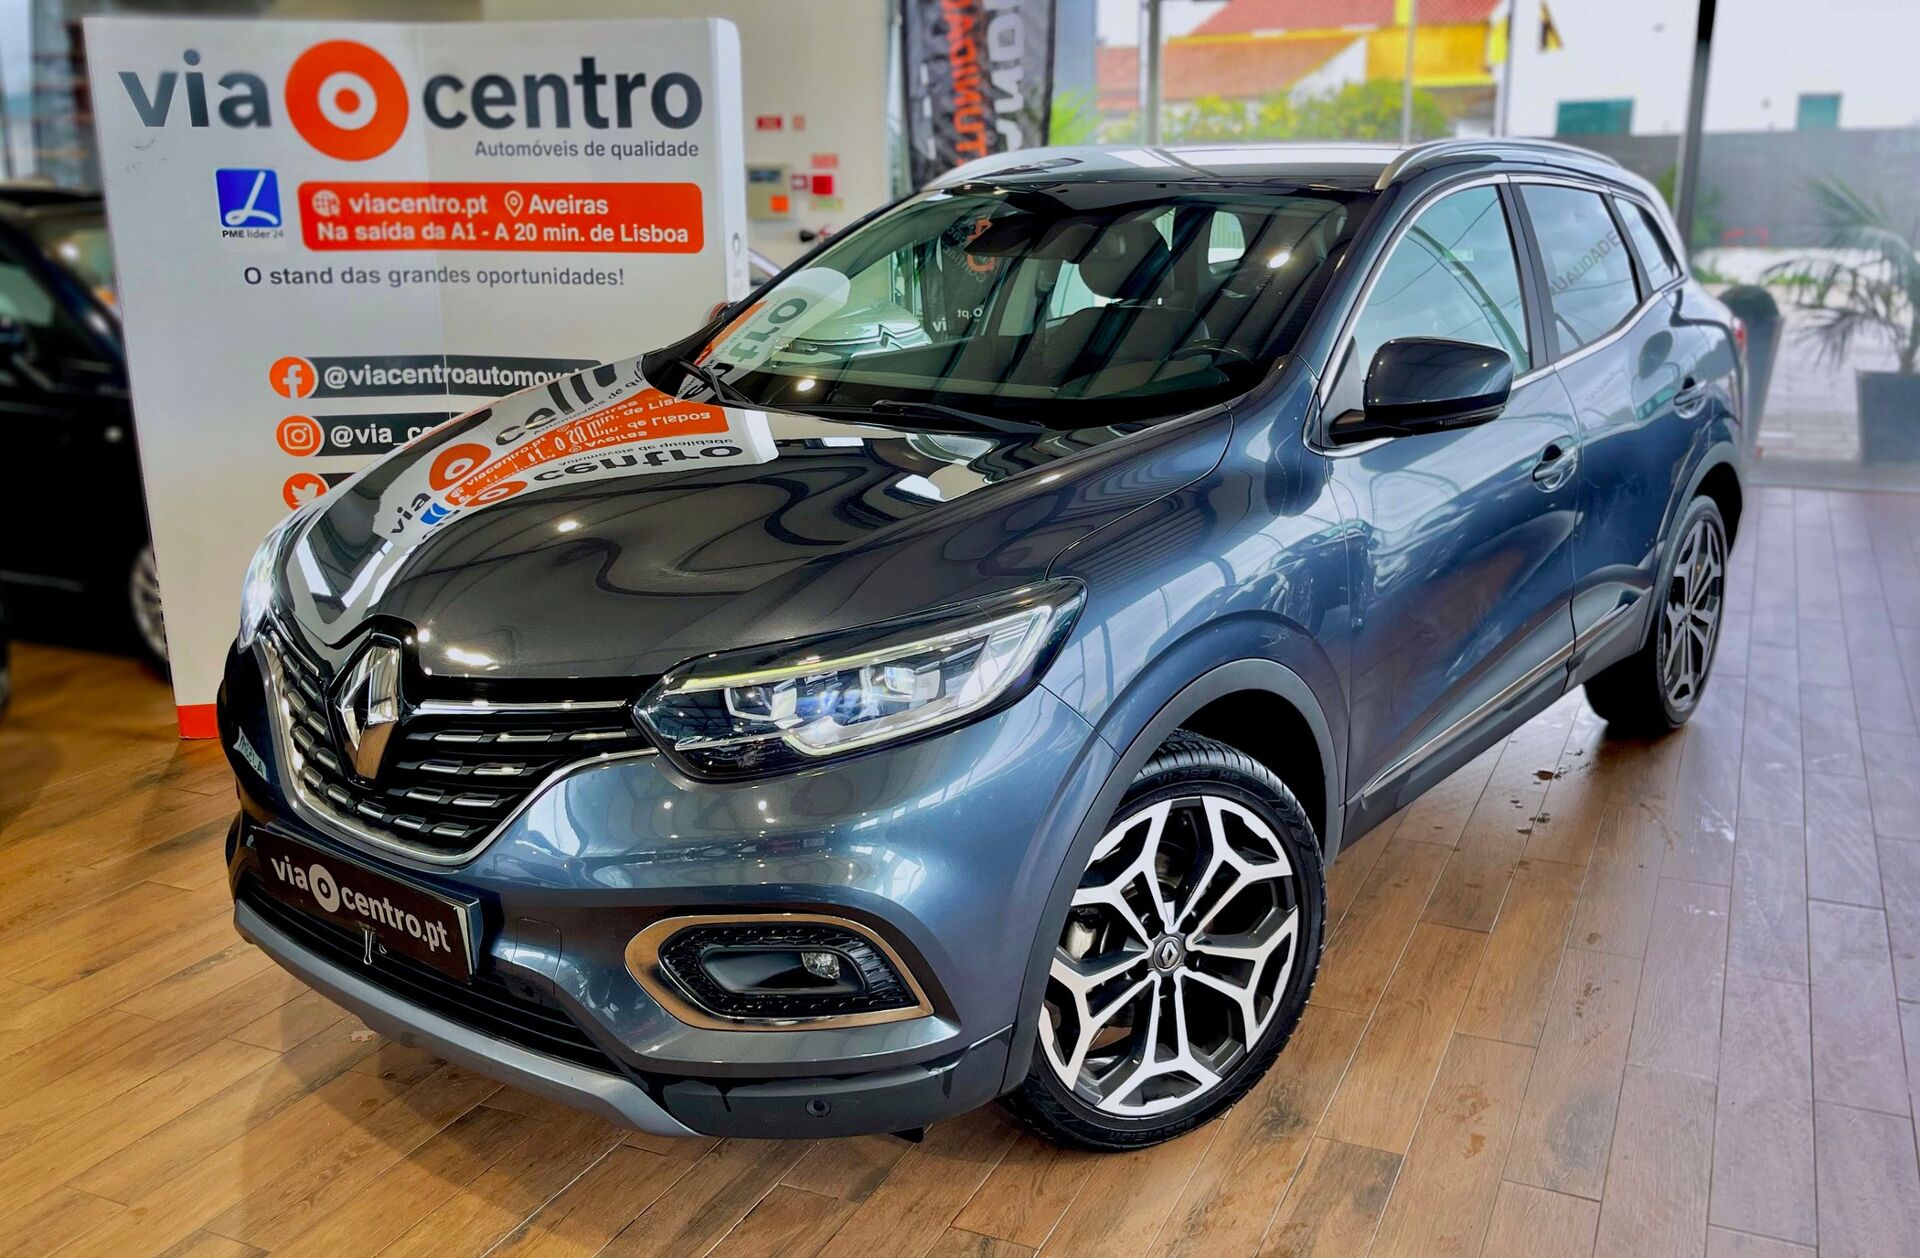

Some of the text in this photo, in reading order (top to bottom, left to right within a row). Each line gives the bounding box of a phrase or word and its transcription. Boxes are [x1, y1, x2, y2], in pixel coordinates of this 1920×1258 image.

[118, 49, 703, 130] via centro
[475, 140, 699, 160] Automóveis de qualidade
[348, 192, 609, 219] viacentro.pt Aveiras
[222, 230, 245, 238] PME
[317, 223, 348, 241] Na
[355, 222, 415, 241] saída
[421, 222, 446, 241] da
[451, 222, 477, 241] A1
[494, 223, 510, 241] A
[514, 223, 537, 241] 20
[543, 223, 585, 242] min.
[590, 223, 615, 242] de
[620, 223, 689, 243] Lisboa
[244, 266, 625, 287] O stand das grandes oportunidades!
[324, 364, 579, 389] @viacentroautomov
[271, 855, 451, 953] via centro.pt
